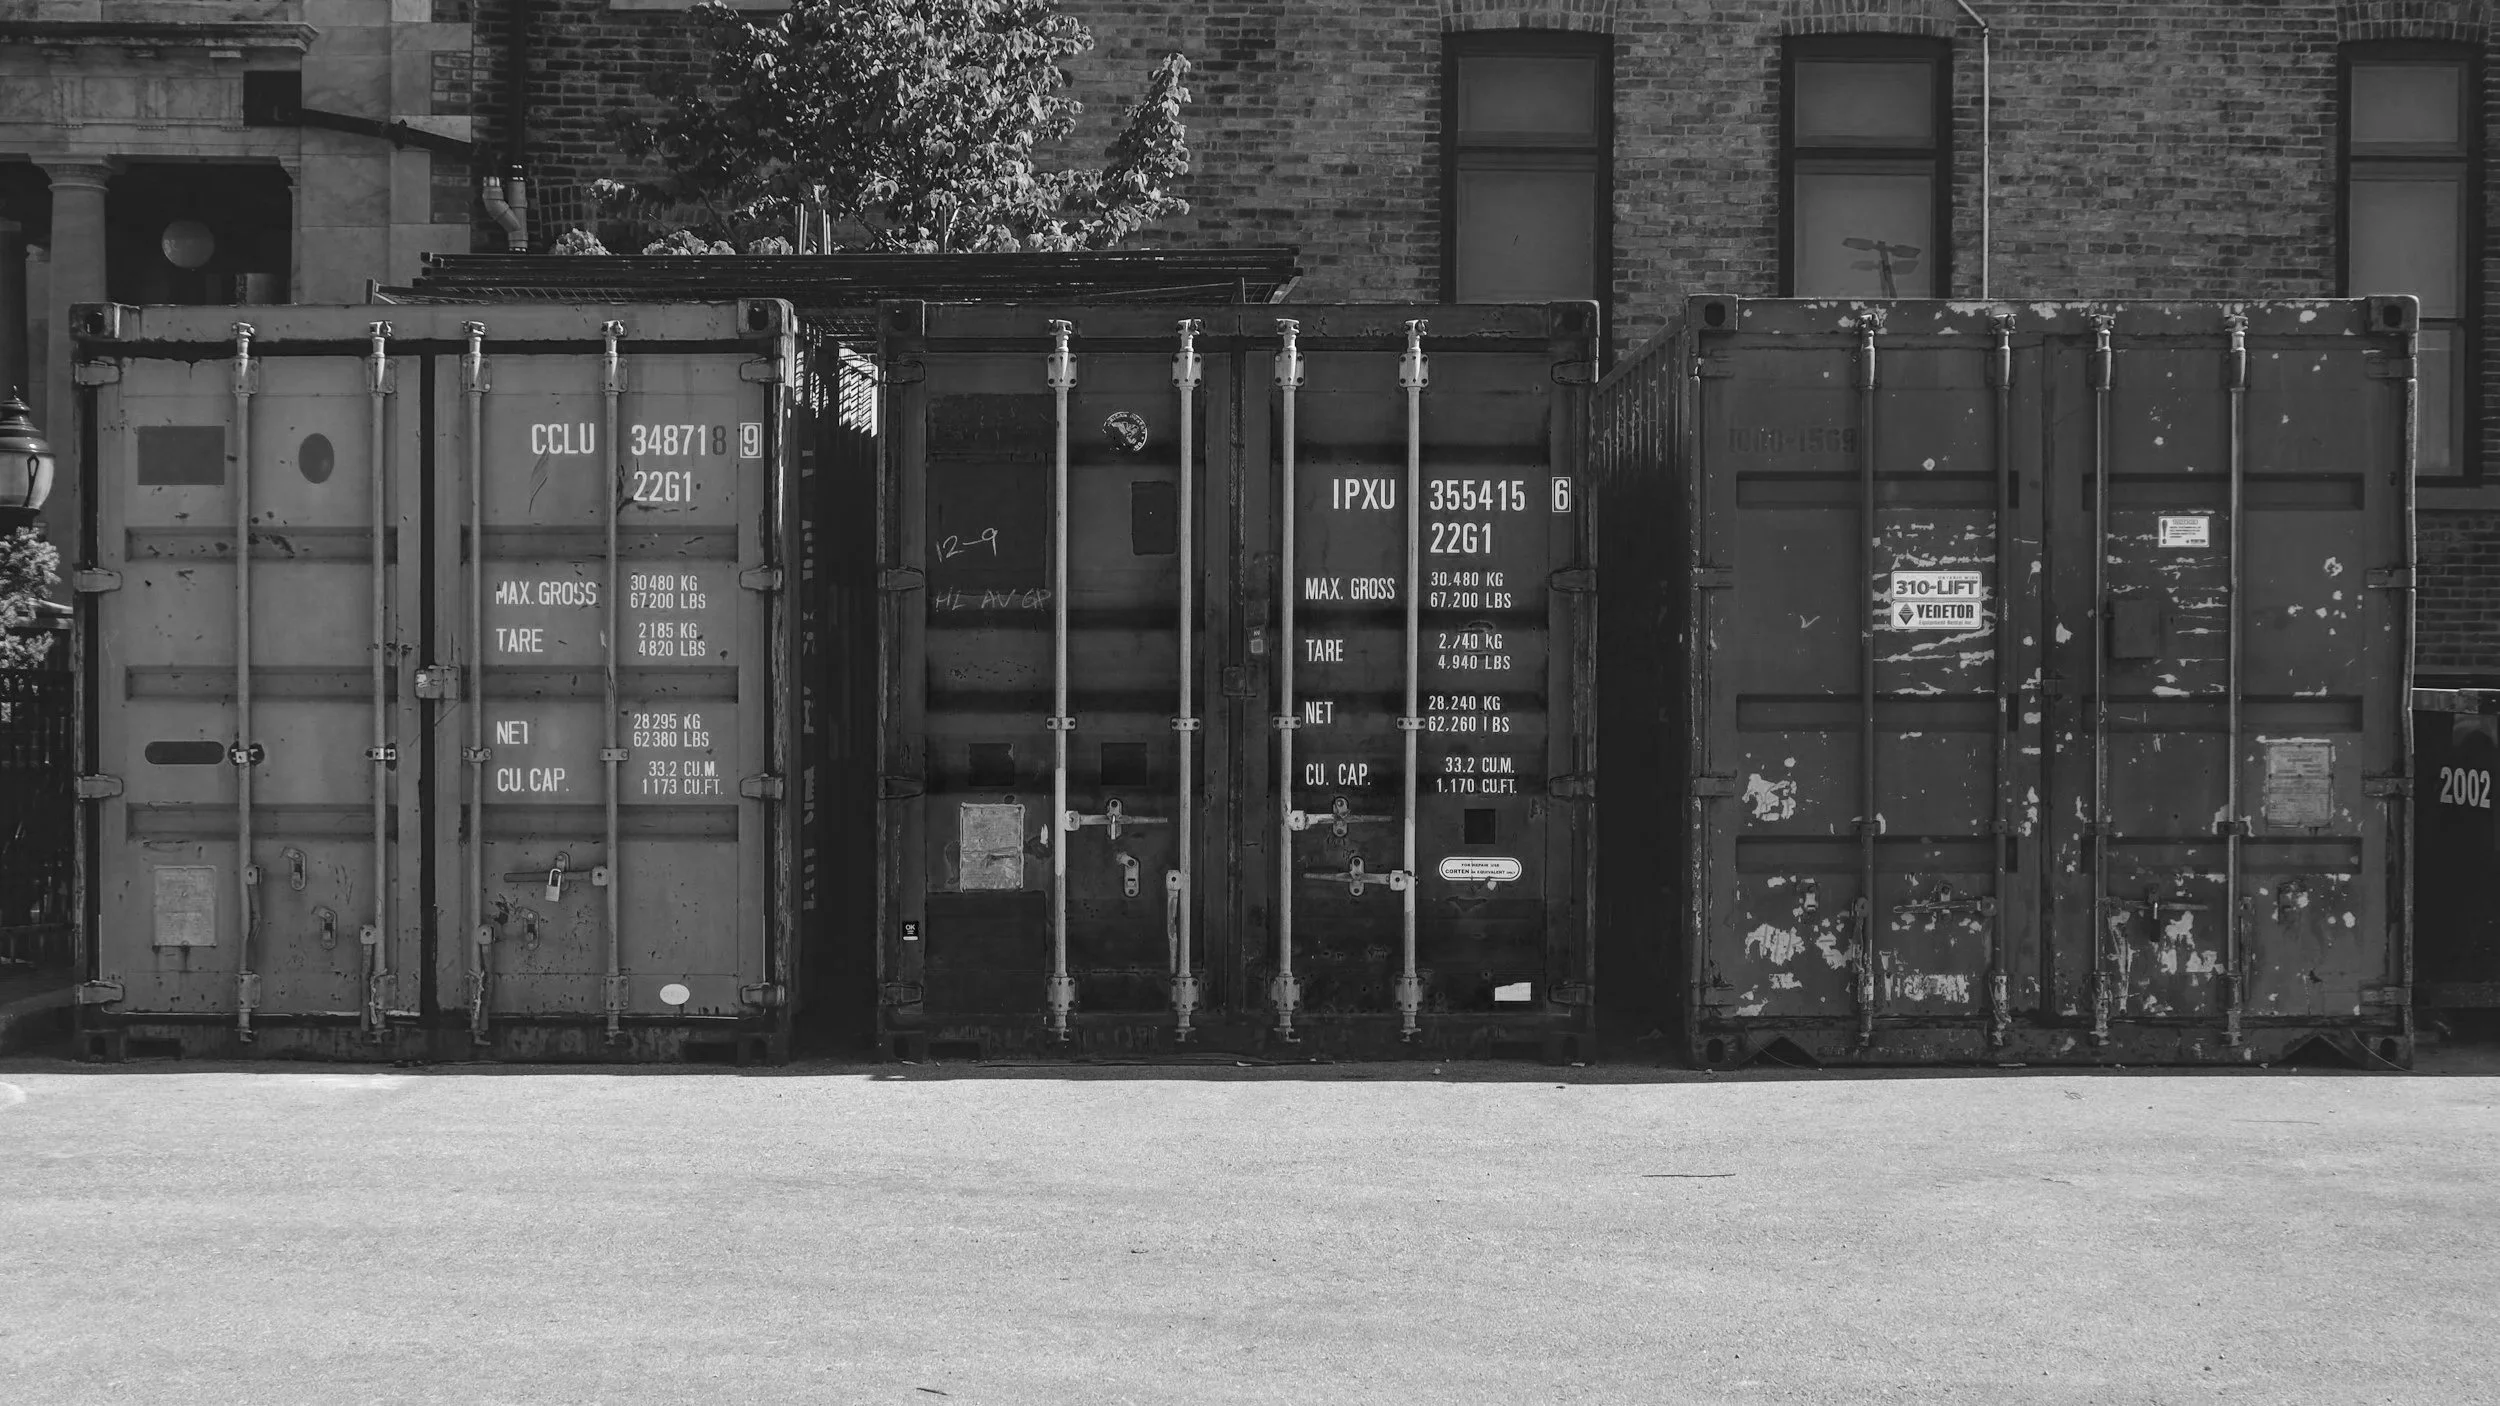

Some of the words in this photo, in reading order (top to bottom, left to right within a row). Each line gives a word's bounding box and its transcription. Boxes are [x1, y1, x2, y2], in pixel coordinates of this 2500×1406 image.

[532, 423, 594, 454] CCLU
[744, 427, 757, 453] 9
[634, 471, 690, 501] 22G1
[1334, 479, 1394, 509] IPXU
[1430, 480, 1525, 511] 355415
[1555, 480, 1568, 509] 6
[1431, 523, 1490, 553] 22G1
[496, 582, 534, 604] MAX.
[539, 582, 596, 605] GROSS
[681, 575, 697, 591] KG
[1306, 578, 1343, 599] MAX.
[1351, 578, 1394, 599] GROSS
[1431, 572, 1478, 586] 30,480
[1487, 572, 1503, 586] KG
[1896, 580, 1978, 595] 310-LIFT
[681, 593, 705, 608] LBS
[1431, 592, 1477, 607] 67,200
[1486, 593, 1511, 608] LBS
[1917, 604, 1974, 619] VENETOR
[496, 629, 543, 652] TARE
[681, 623, 696, 638] KG
[681, 641, 705, 656] LBS
[1306, 640, 1343, 661] TARE
[1486, 634, 1502, 649] KG
[1439, 655, 1477, 669] 4,940
[1485, 656, 1510, 669] LBS
[684, 714, 700, 729] KG
[1306, 702, 1333, 723] NET
[1429, 696, 1476, 710] 28,240
[1484, 696, 1500, 710] KG
[1429, 716, 1476, 731] 62,260
[684, 732, 708, 747] LBS
[498, 768, 524, 791] CU.
[530, 768, 568, 791] CAP.
[649, 761, 676, 776] 33.2
[1306, 764, 1328, 785] CU.
[1339, 763, 1370, 785] CAP.
[1446, 757, 1474, 772] 33.2
[1437, 778, 1474, 792] 1,170
[2441, 767, 2490, 808] 2002
